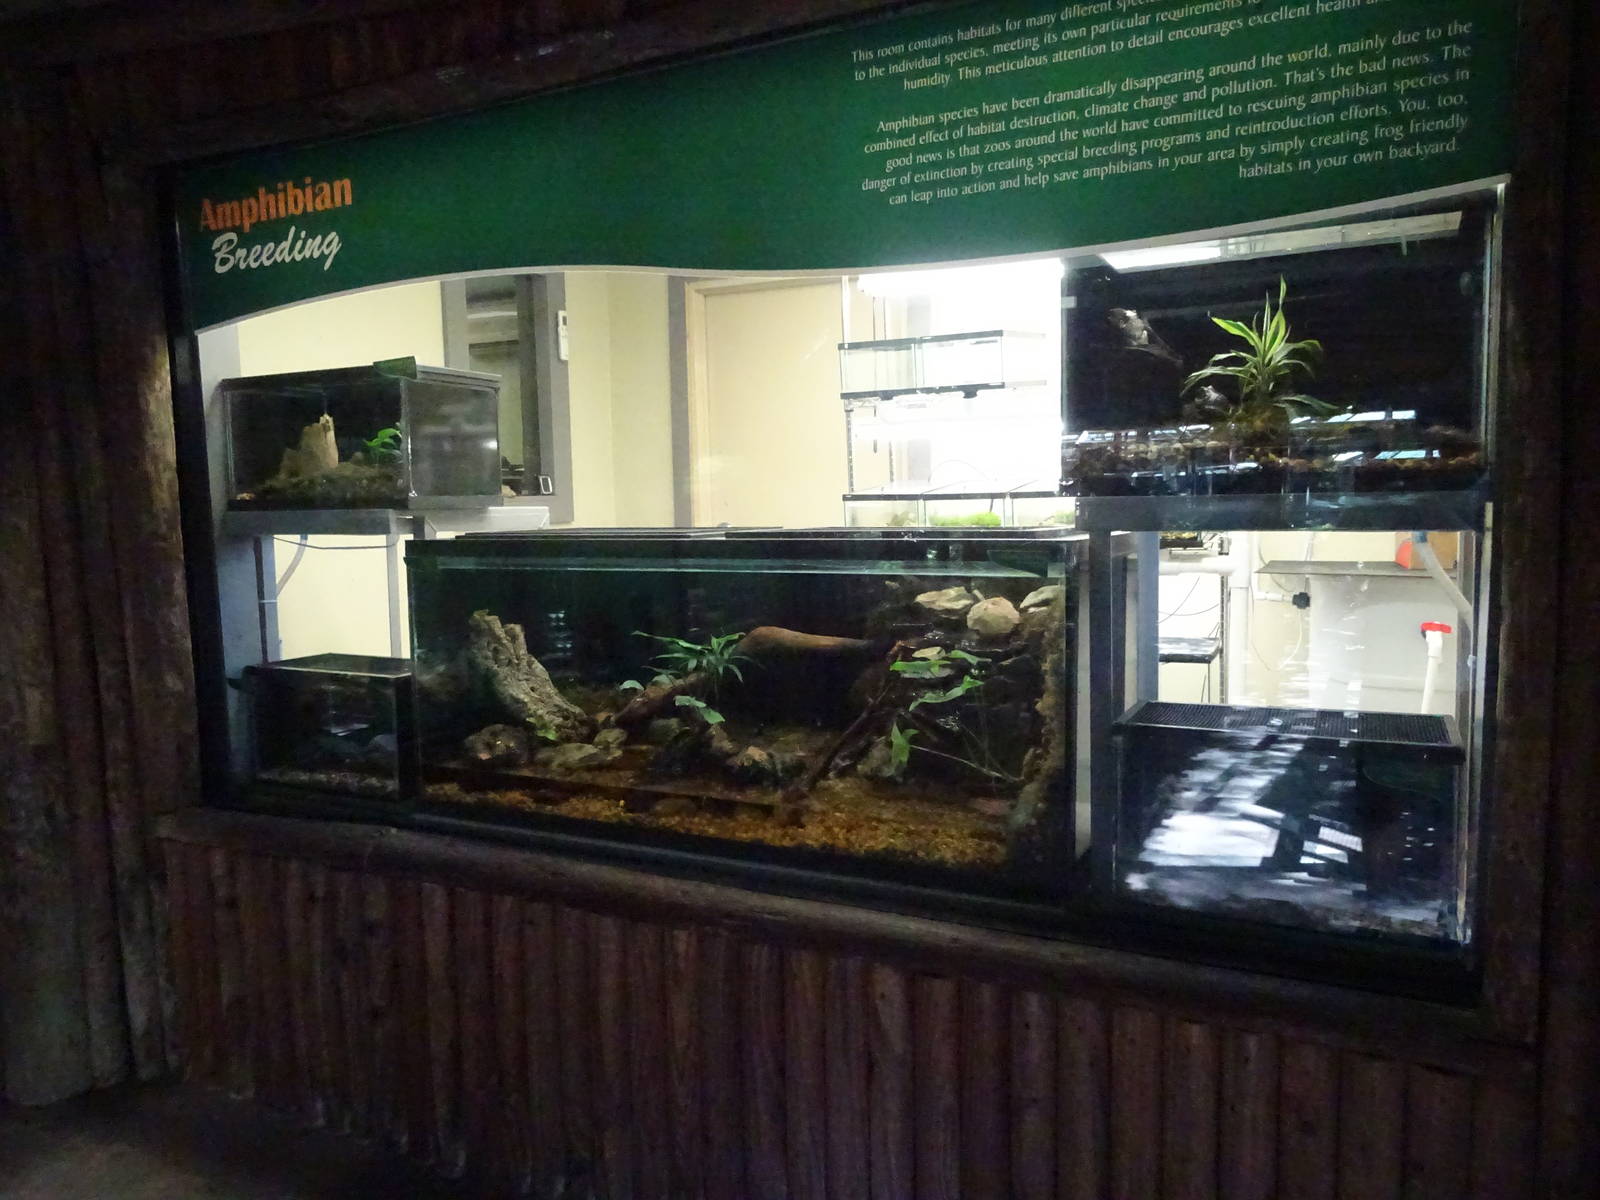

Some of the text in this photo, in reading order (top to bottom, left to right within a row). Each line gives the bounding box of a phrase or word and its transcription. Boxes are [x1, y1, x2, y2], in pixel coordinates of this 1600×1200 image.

[851, 49, 874, 63] This
[877, 43, 905, 58] room
[908, 33, 953, 51] contains
[957, 23, 1001, 42] habitats
[1005, 18, 1021, 32] for
[1025, 11, 1057, 28] many
[1060, 0, 1112, 21] different
[855, 70, 866, 81] to
[869, 65, 885, 78] the
[888, 52, 941, 74] individual
[993, 36, 1040, 54] meeting
[1044, 32, 1058, 44] its
[1062, 27, 1087, 41] own
[1091, 12, 1151, 40] particular
[958, 66, 981, 80] This
[986, 54, 1048, 75] meticulous
[1052, 43, 1106, 63] attention
[1111, 40, 1124, 52] to
[1128, 29, 1163, 49] detail
[1167, 18, 1244, 41] encourages
[1248, 4, 1311, 27] excellent
[864, 133, 916, 153] combined
[919, 129, 949, 145] effect
[952, 125, 964, 140] of
[967, 120, 1006, 137] habitat
[1084, 101, 1129, 118] climate
[1133, 93, 1179, 110] change
[1183, 85, 1207, 102] and
[1211, 78, 1277, 102] pollution.
[1283, 67, 1325, 85] That's
[1331, 63, 1353, 78] the
[1359, 56, 1386, 73] bad
[1392, 53, 1434, 69] news.
[1442, 44, 1472, 61] The
[876, 113, 935, 134] Amphibian
[938, 105, 979, 126] species
[982, 101, 1008, 114] have
[1011, 96, 1040, 110] been
[1043, 80, 1117, 105] dramatically
[1120, 68, 1204, 92] disappearing
[1209, 55, 1257, 77] around
[1261, 52, 1283, 68] the
[1338, 33, 1388, 54] mainly
[1391, 30, 1420, 46] due
[1425, 26, 1442, 40] to
[1448, 20, 1472, 36] the
[862, 177, 896, 192] danger
[900, 171, 912, 185] of
[914, 165, 967, 183] extinction
[970, 161, 985, 178] by
[988, 157, 1034, 171] creating
[1038, 146, 1078, 168] special
[1083, 140, 1137, 158] breeding
[1142, 132, 1201, 154] programs
[1206, 123, 1230, 141] and
[1235, 111, 1335, 136] reintroduction
[1340, 103, 1390, 121] efforts.
[885, 68, 1470, 173] good news is that zoos around the world have committed to rescuing amphibian species in
[889, 112, 1469, 205] can leap into action and help save amphibians in your area by simply creating frog friendly
[1239, 137, 1459, 178] habitats in your own backyard.
[200, 176, 353, 233] Amphibian
[212, 225, 342, 274] Breeding
